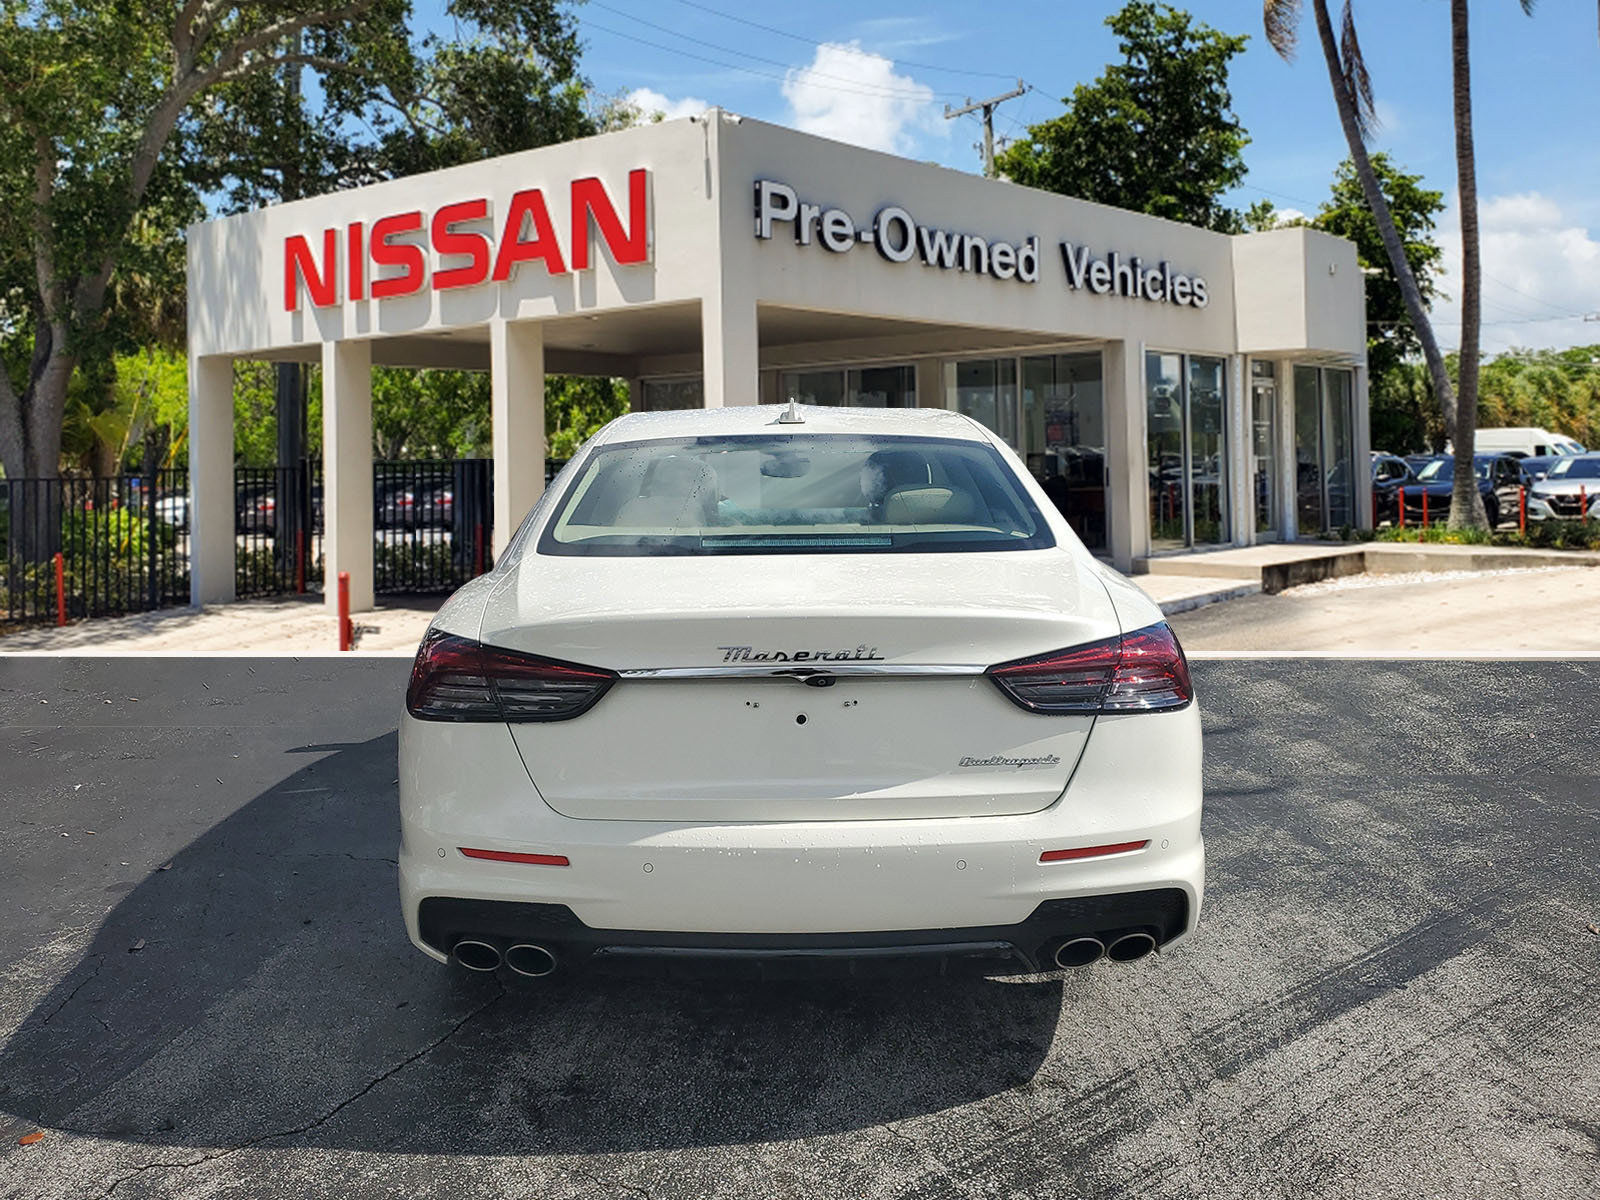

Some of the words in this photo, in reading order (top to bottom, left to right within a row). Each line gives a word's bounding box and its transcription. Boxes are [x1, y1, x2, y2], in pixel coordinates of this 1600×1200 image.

[284, 168, 648, 311] NISSAN
[754, 179, 1039, 283] Pre-Owned
[1060, 241, 1209, 308] Vehicles
[717, 645, 885, 663] Maserati
